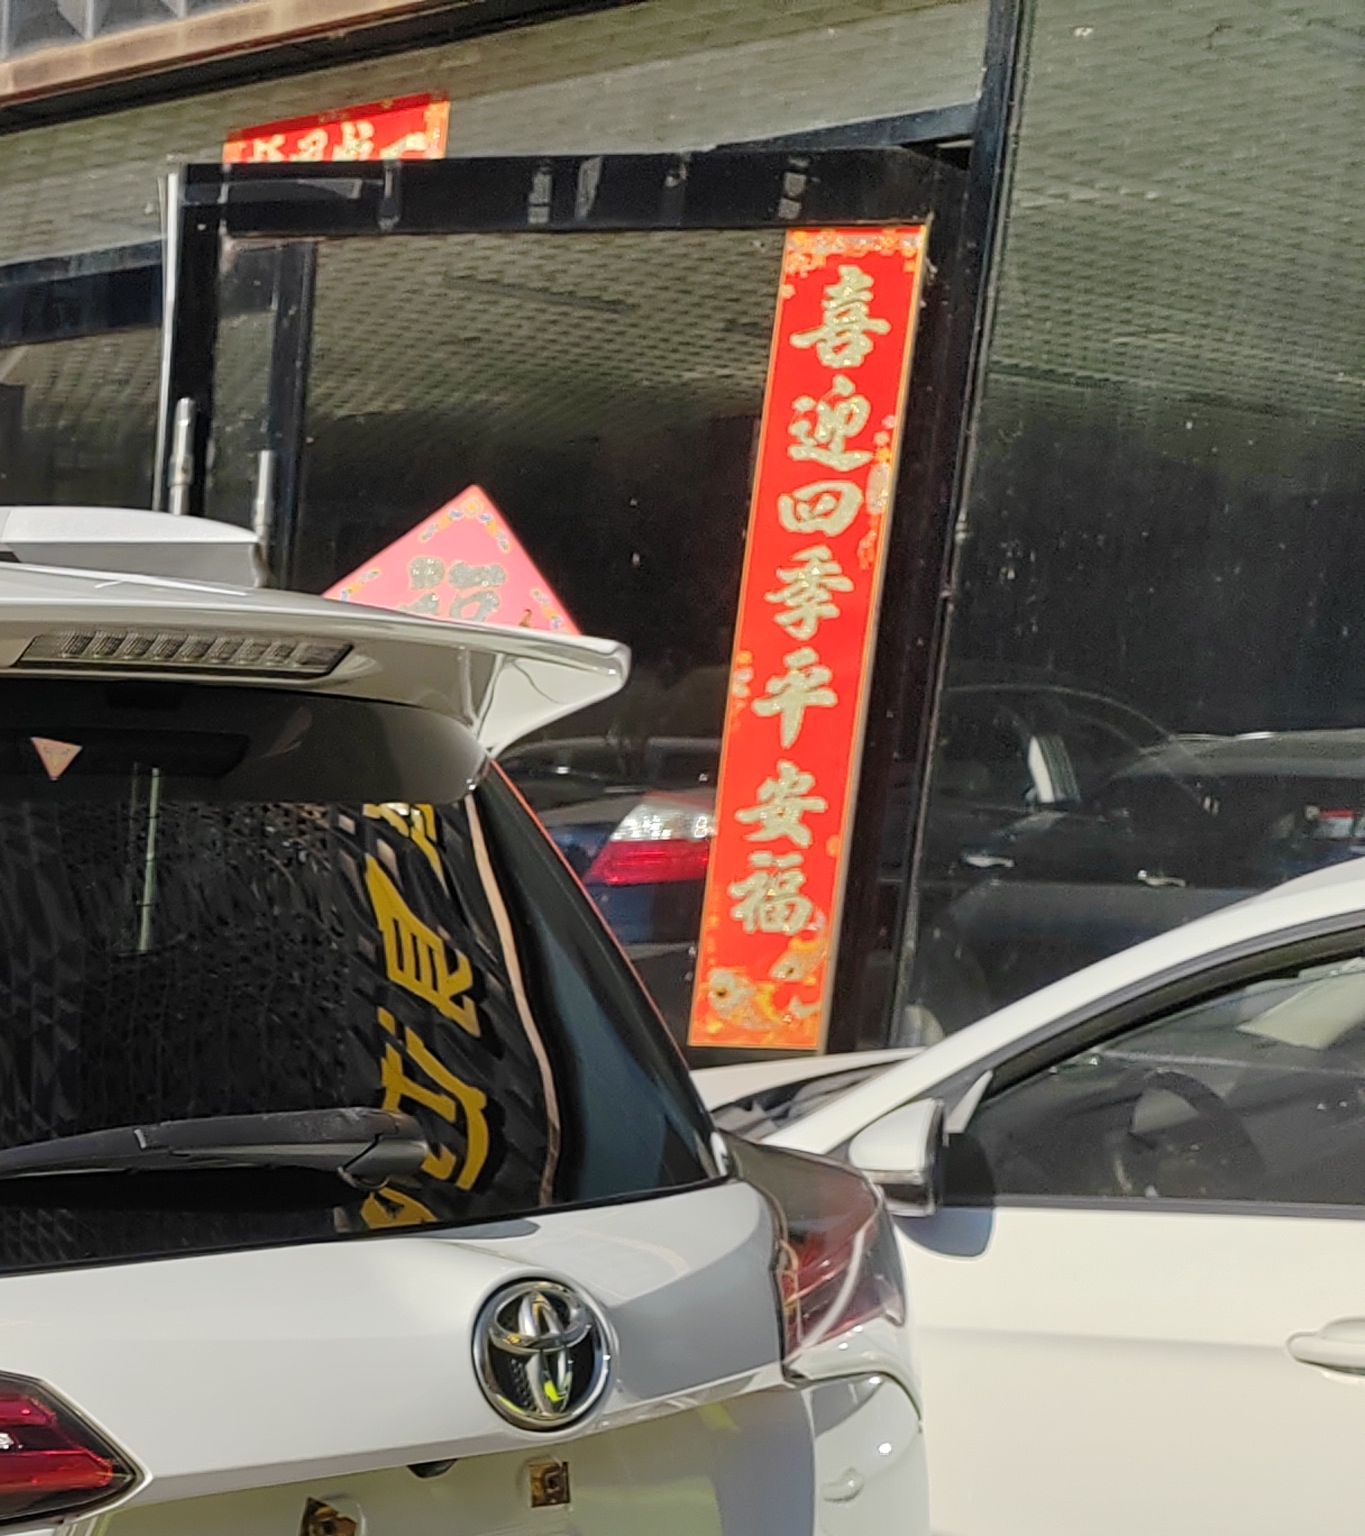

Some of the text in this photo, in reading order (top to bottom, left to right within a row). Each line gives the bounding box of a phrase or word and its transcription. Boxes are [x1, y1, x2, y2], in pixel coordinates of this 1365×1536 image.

[730, 265, 893, 938] 喜迎四季平安福
